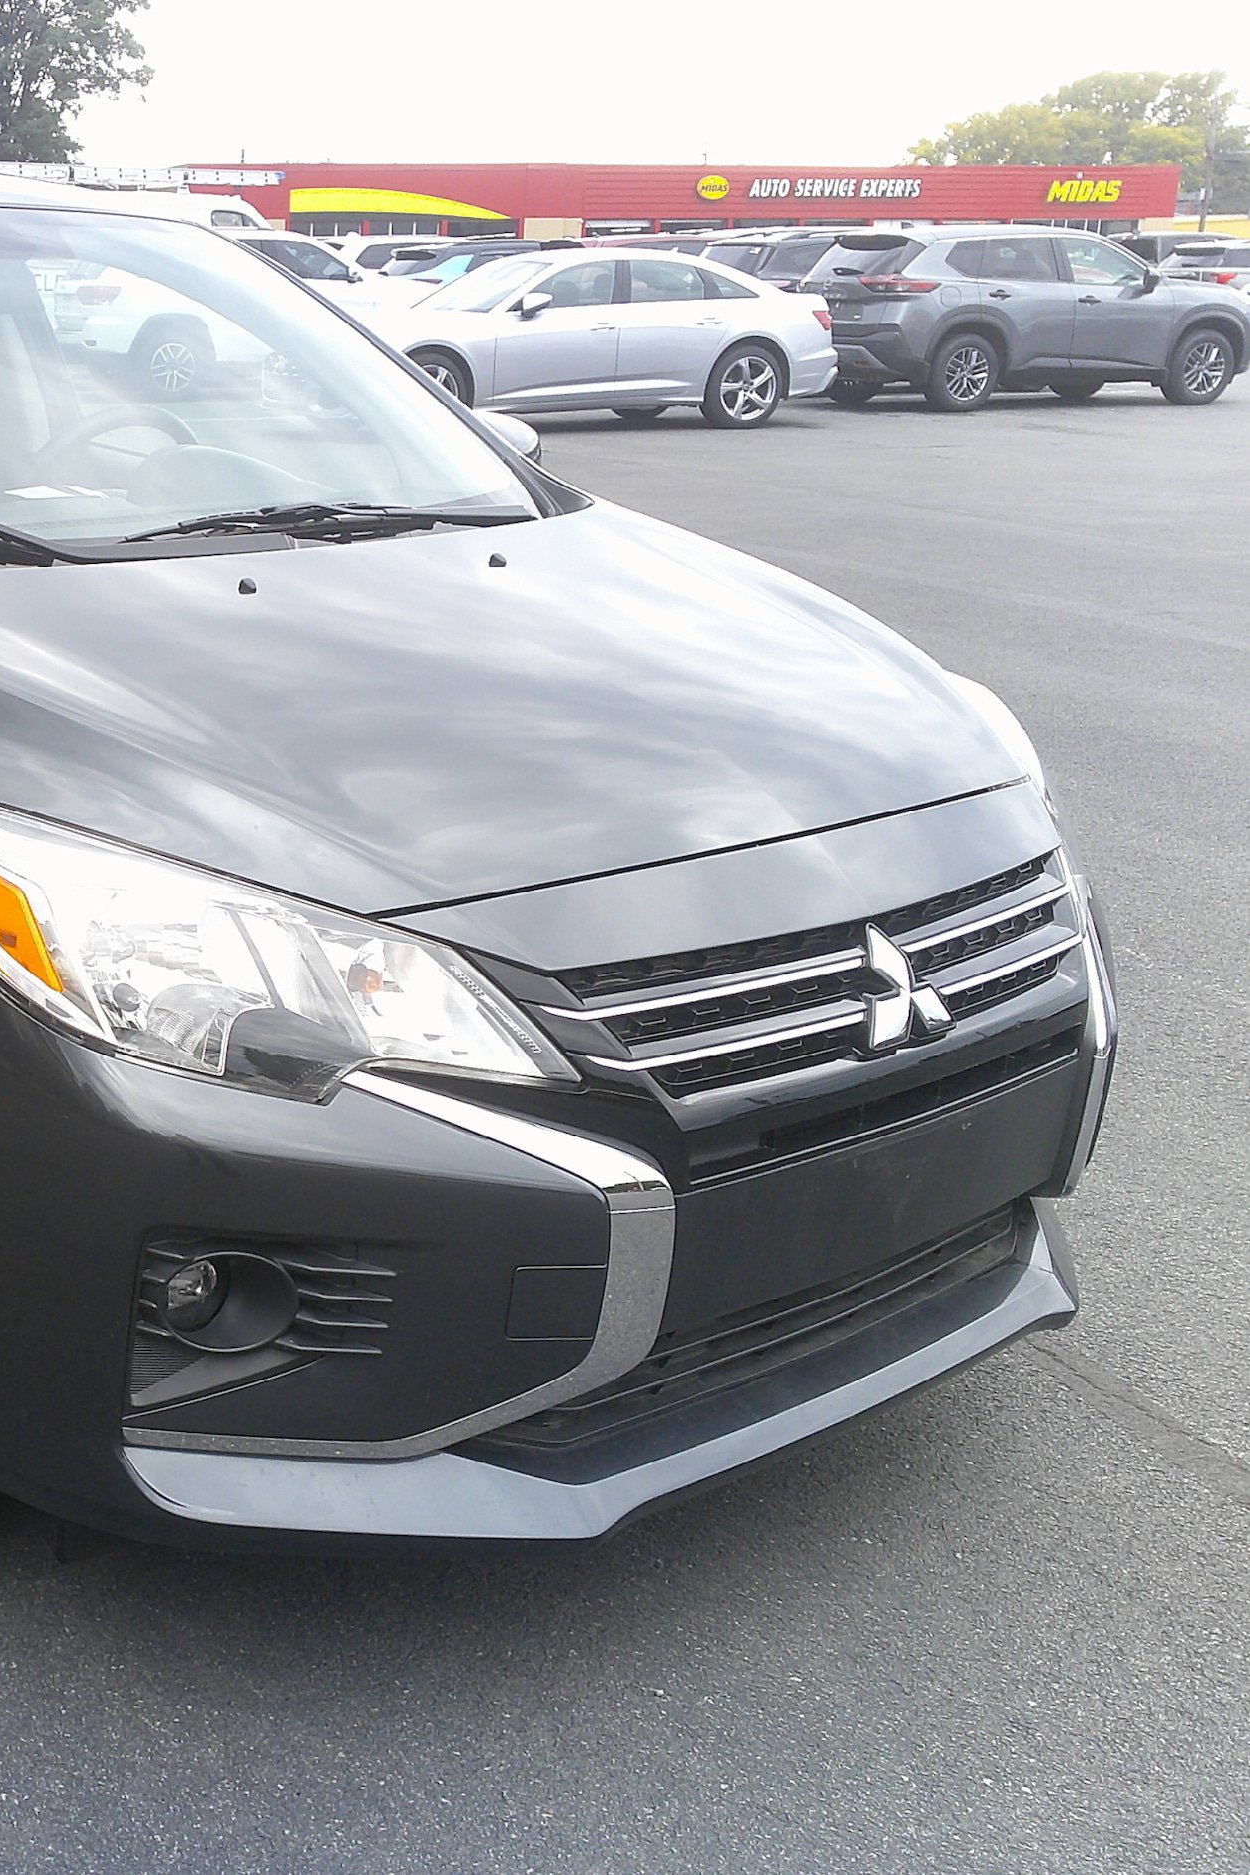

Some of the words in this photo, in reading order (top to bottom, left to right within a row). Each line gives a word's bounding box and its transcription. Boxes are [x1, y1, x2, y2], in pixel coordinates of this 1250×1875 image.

[701, 184, 728, 192] MIDAS
[749, 178, 790, 198] AUTO
[794, 178, 856, 198] SERVICE
[859, 178, 922, 198] EXPERTS
[1046, 180, 1123, 203] MIDAS
